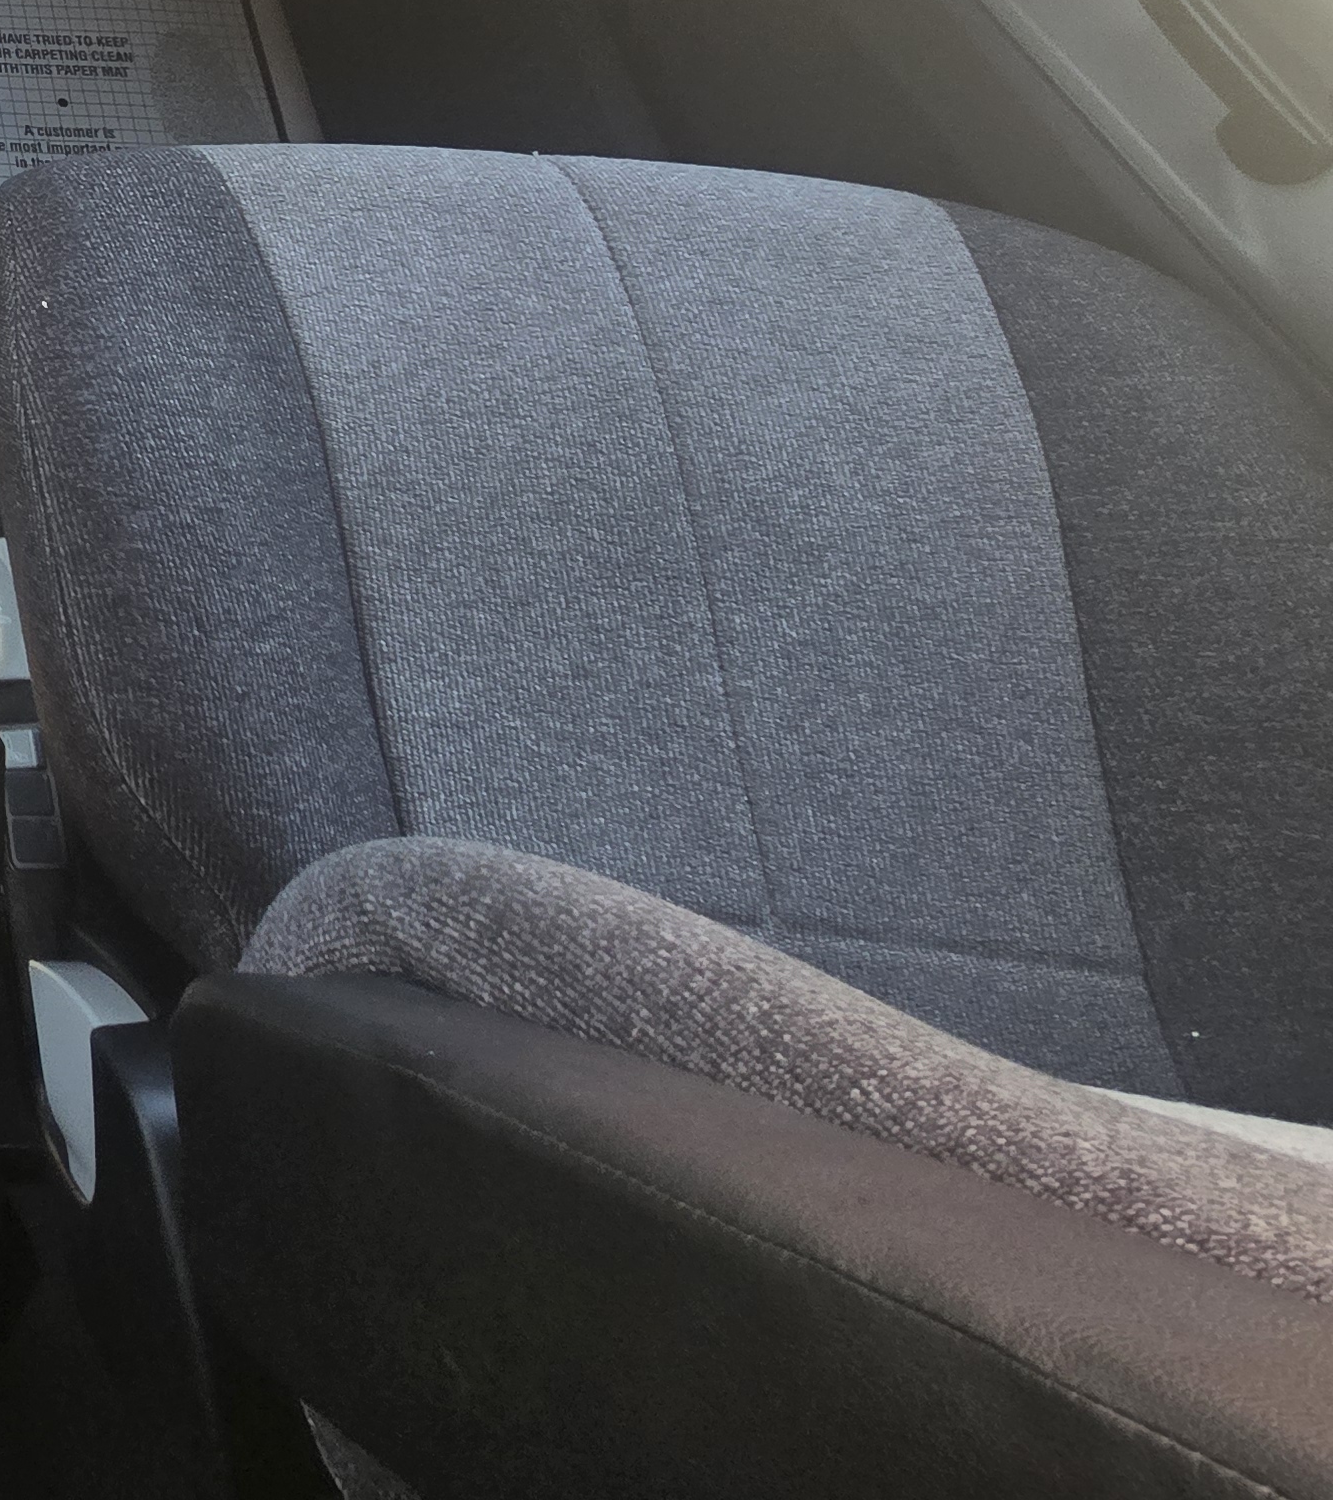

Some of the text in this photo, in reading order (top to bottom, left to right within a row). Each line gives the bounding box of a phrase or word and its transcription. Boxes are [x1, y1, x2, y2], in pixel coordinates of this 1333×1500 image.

[34, 34, 72, 46] TRIED
[75, 35, 93, 46] TO
[96, 36, 129, 47] KEEP
[15, 48, 88, 61] CARPETING
[91, 50, 133, 63] CLEAN
[23, 63, 53, 75] THIS
[57, 64, 98, 77] PAPER
[101, 65, 130, 78] MAT
[23, 124, 116, 139] A customer is
[9, 141, 42, 153] most
[14, 156, 28, 168] in
